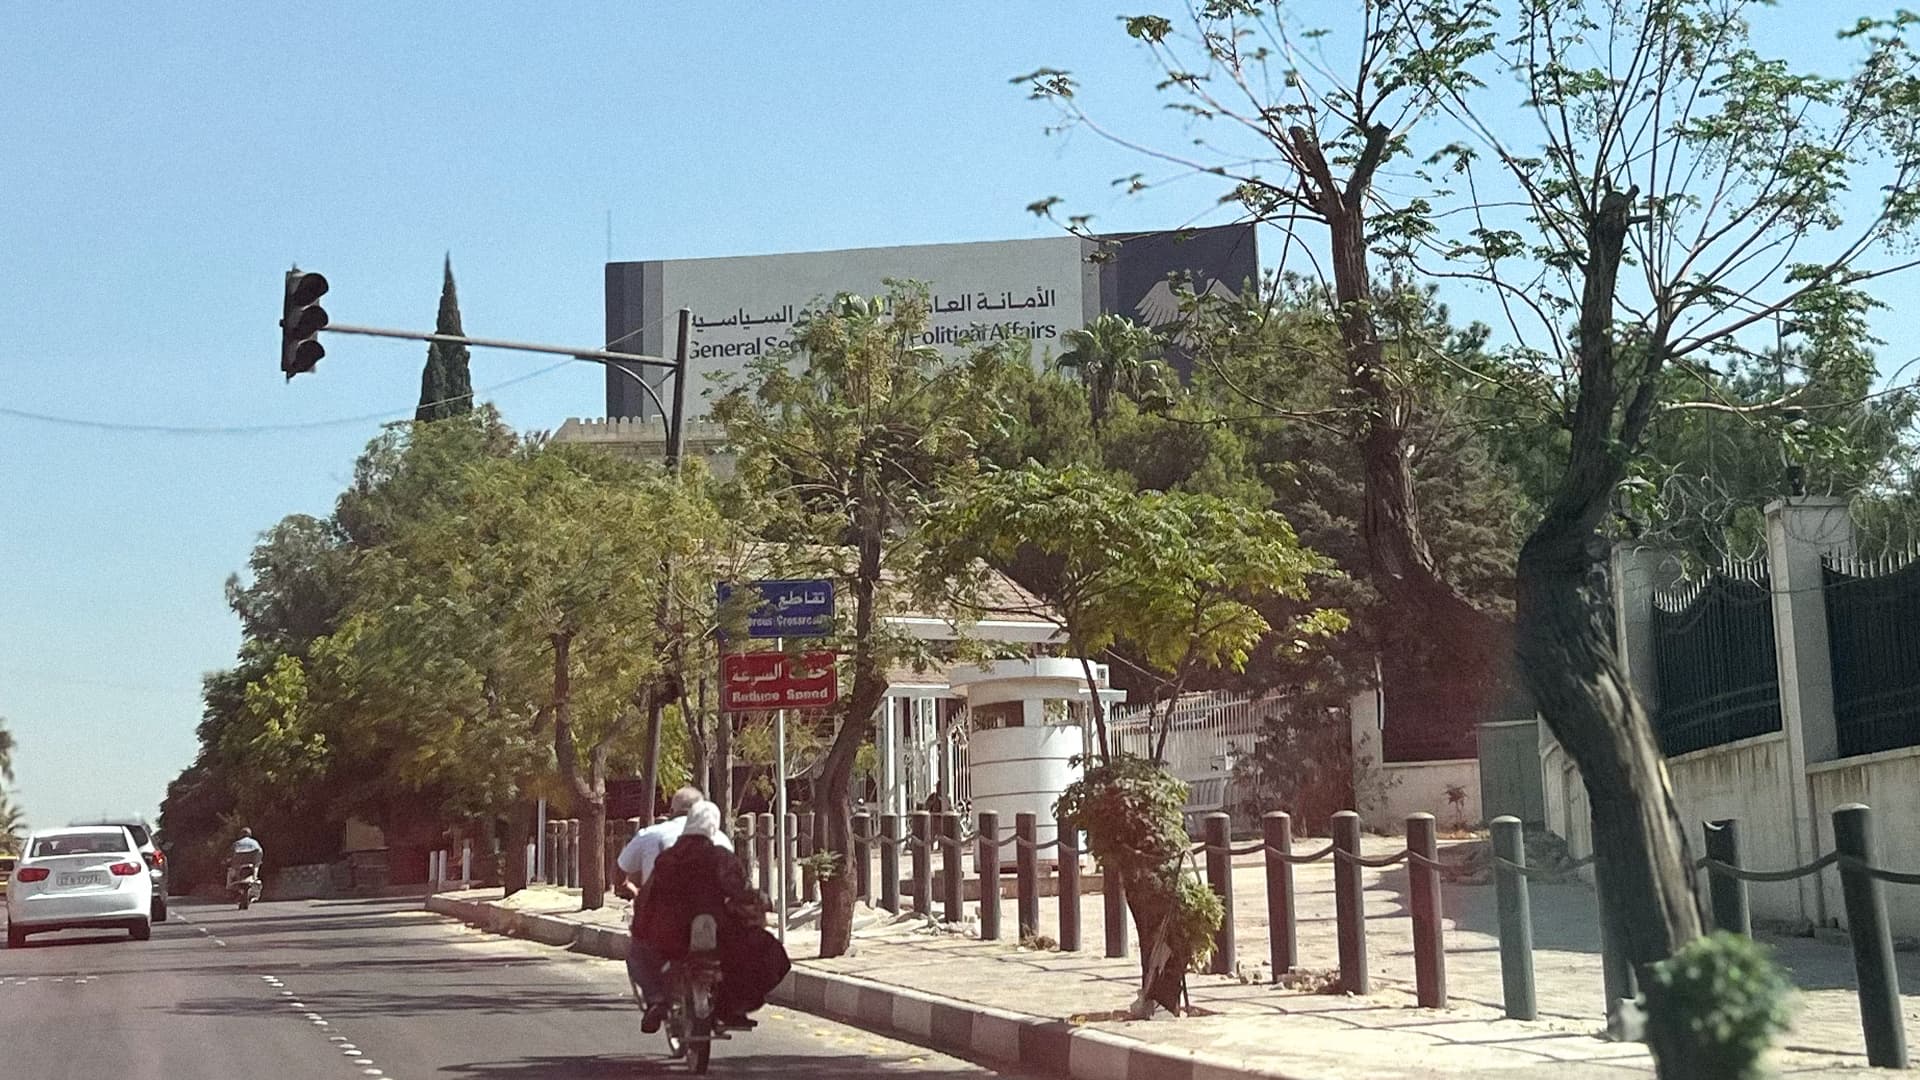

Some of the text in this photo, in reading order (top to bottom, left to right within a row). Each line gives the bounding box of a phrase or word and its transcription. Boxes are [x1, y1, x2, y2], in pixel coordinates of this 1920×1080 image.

[976, 285, 1056, 310] الأمانة
[732, 687, 829, 703] Reduce Speed
